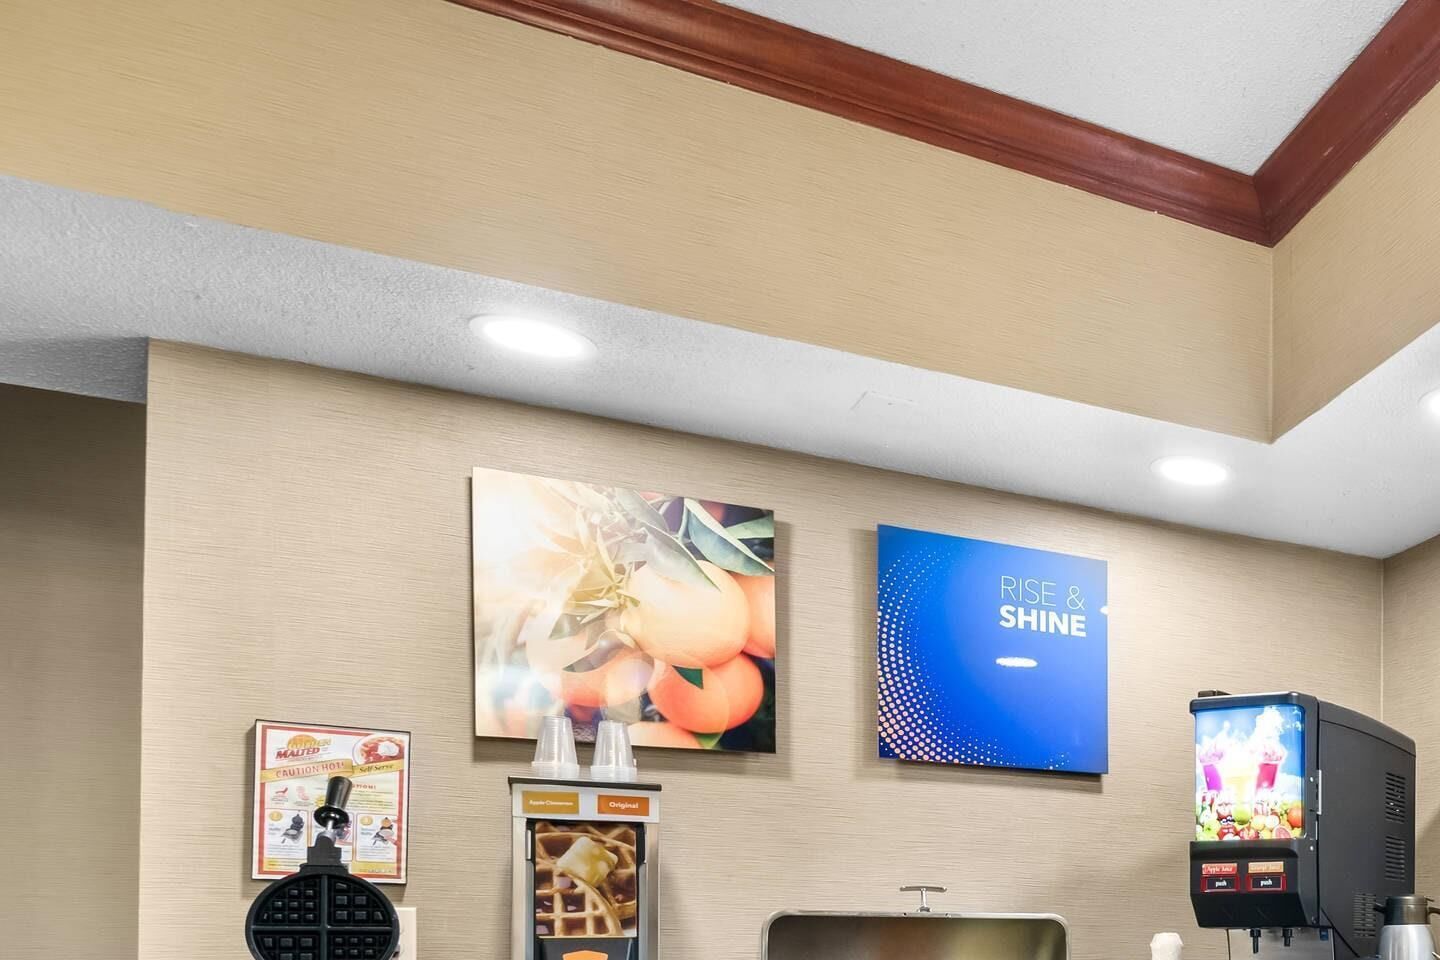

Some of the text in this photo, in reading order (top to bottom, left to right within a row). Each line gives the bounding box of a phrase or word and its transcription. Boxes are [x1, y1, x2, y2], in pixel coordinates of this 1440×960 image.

[1001, 575, 1085, 610] RISE &
[999, 604, 1086, 637] SHINE
[275, 747, 321, 759] MALTED
[275, 761, 344, 778] CAUTION HOT!
[609, 801, 639, 810] Original
[1260, 879, 1273, 887] push
